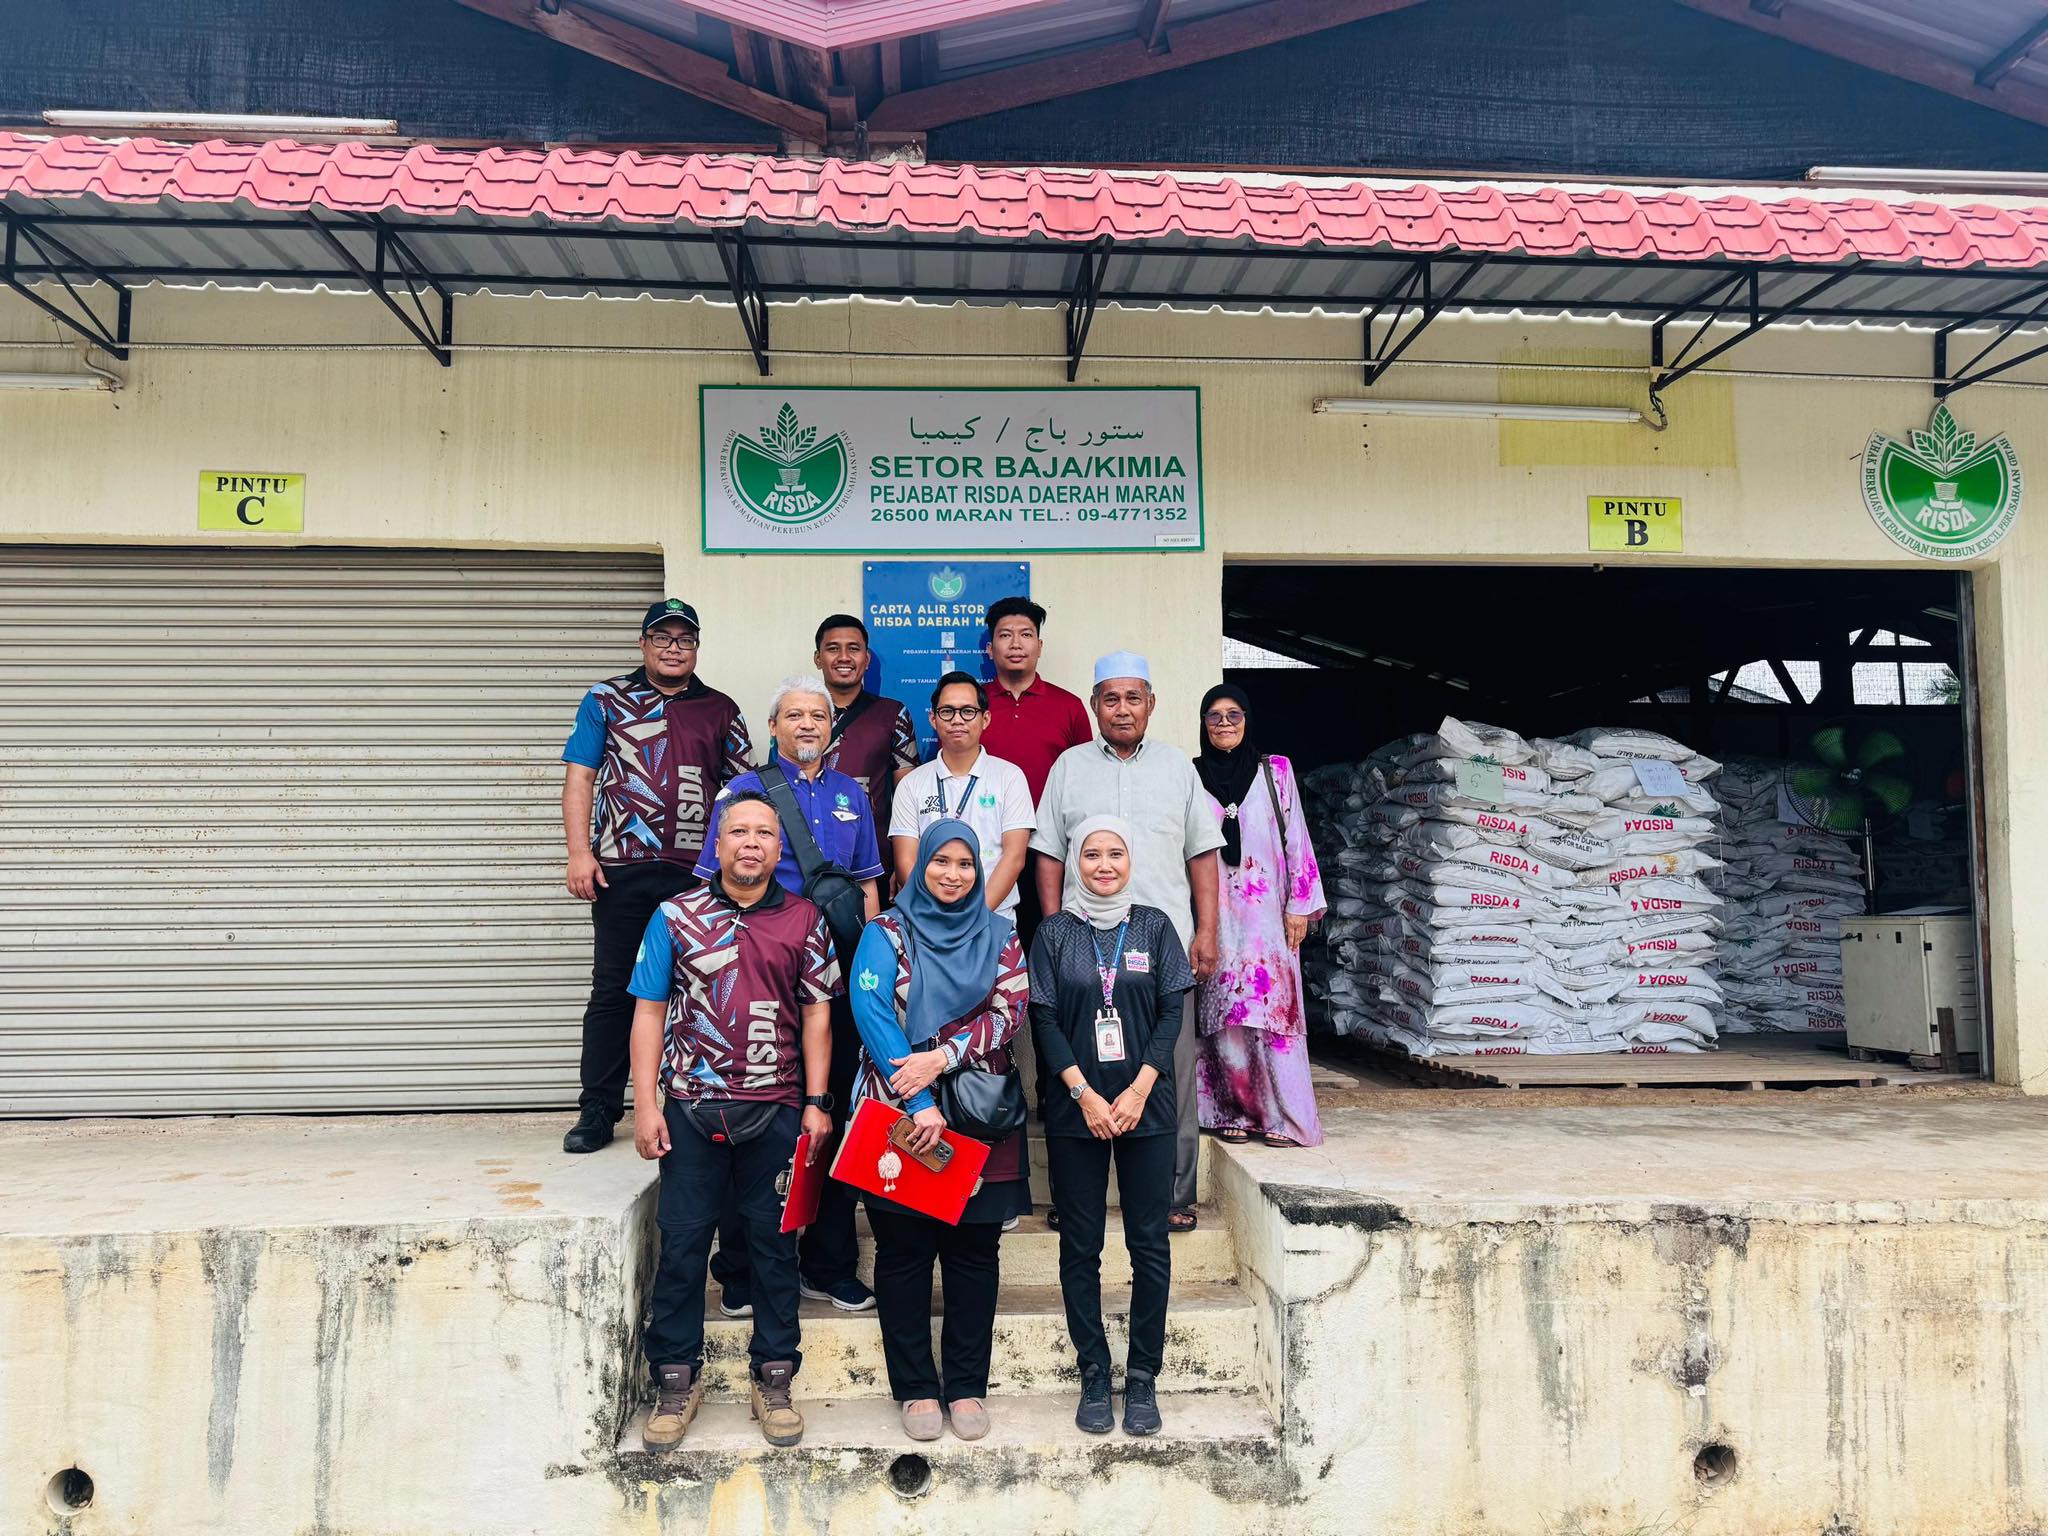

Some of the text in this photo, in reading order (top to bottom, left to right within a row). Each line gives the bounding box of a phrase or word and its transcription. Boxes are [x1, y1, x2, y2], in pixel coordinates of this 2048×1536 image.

[909, 416, 981, 445] كيميا
[1025, 417, 1066, 453] باج
[1078, 425, 1144, 446] ستور
[1866, 435, 1886, 465] PIHAK
[871, 455, 1187, 479] SETOR BAJA/KIMIA
[216, 476, 287, 494] PINTU
[870, 485, 1185, 504] PEJABAT RISDA DAERAH MARAN
[1865, 468, 1885, 520] BERKUASA
[236, 496, 265, 525] C
[762, 490, 821, 514] RISDA
[1604, 501, 1667, 517] PINTU
[871, 508, 1187, 522] 26500 MARAN TEL.: 09-4771352
[1915, 505, 1977, 532] RISDA
[1624, 519, 1649, 546] B
[1881, 515, 1930, 555] KEMAJUAN
[1976, 529, 2003, 551] KECIL
[870, 604, 985, 614] CARTA ALIR STOR
[874, 617, 912, 627] RISDA
[918, 617, 970, 627] DAERAH
[674, 765, 705, 850] RISDA
[1477, 813, 1516, 833] RISDA
[1519, 823, 1528, 835] 4
[1489, 850, 1529, 872] RISDA
[1531, 864, 1539, 875] 4
[1793, 858, 1827, 871] RISDA
[1609, 866, 1648, 884] RISDA
[1650, 864, 1658, 878] 4
[1471, 893, 1520, 909] RISDA 4
[1641, 897, 1682, 910] RISDA
[1786, 921, 1821, 932] RISDA
[1639, 938, 1677, 951] RISDA
[1781, 961, 1818, 974] RISDA
[1649, 974, 1688, 985] RISDA
[1807, 990, 1844, 1001] RISDA
[1808, 1018, 1845, 1029] RISDA
[743, 1000, 780, 1090] RISDA
